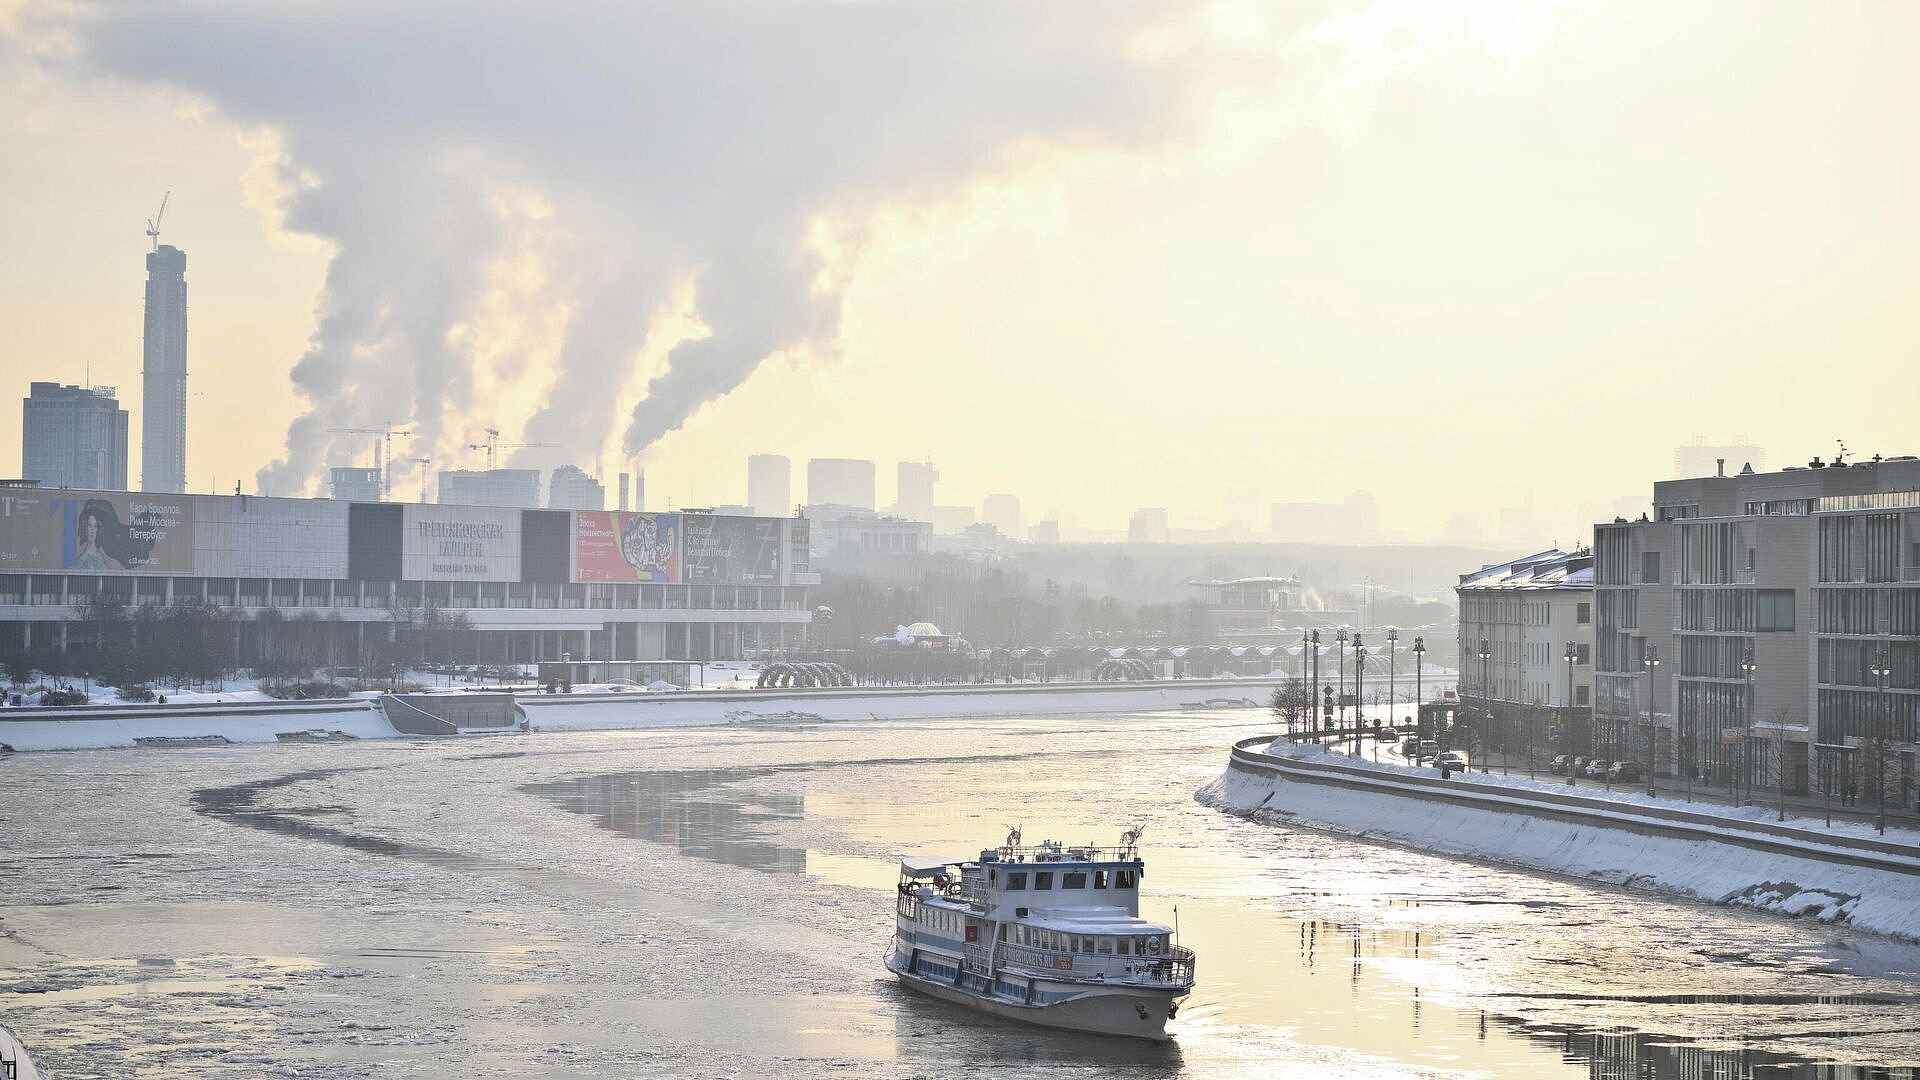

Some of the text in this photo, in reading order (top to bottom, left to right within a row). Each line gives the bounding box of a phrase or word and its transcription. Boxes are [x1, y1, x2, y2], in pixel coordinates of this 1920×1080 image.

[129, 501, 147, 514] Карл
[419, 520, 504, 539] ТРЕТЬЯКОВСКАЯ
[579, 518, 596, 528] Эпоха
[129, 528, 168, 543] Петербург
[440, 541, 484, 558] ГАЛЕРЕЯ
